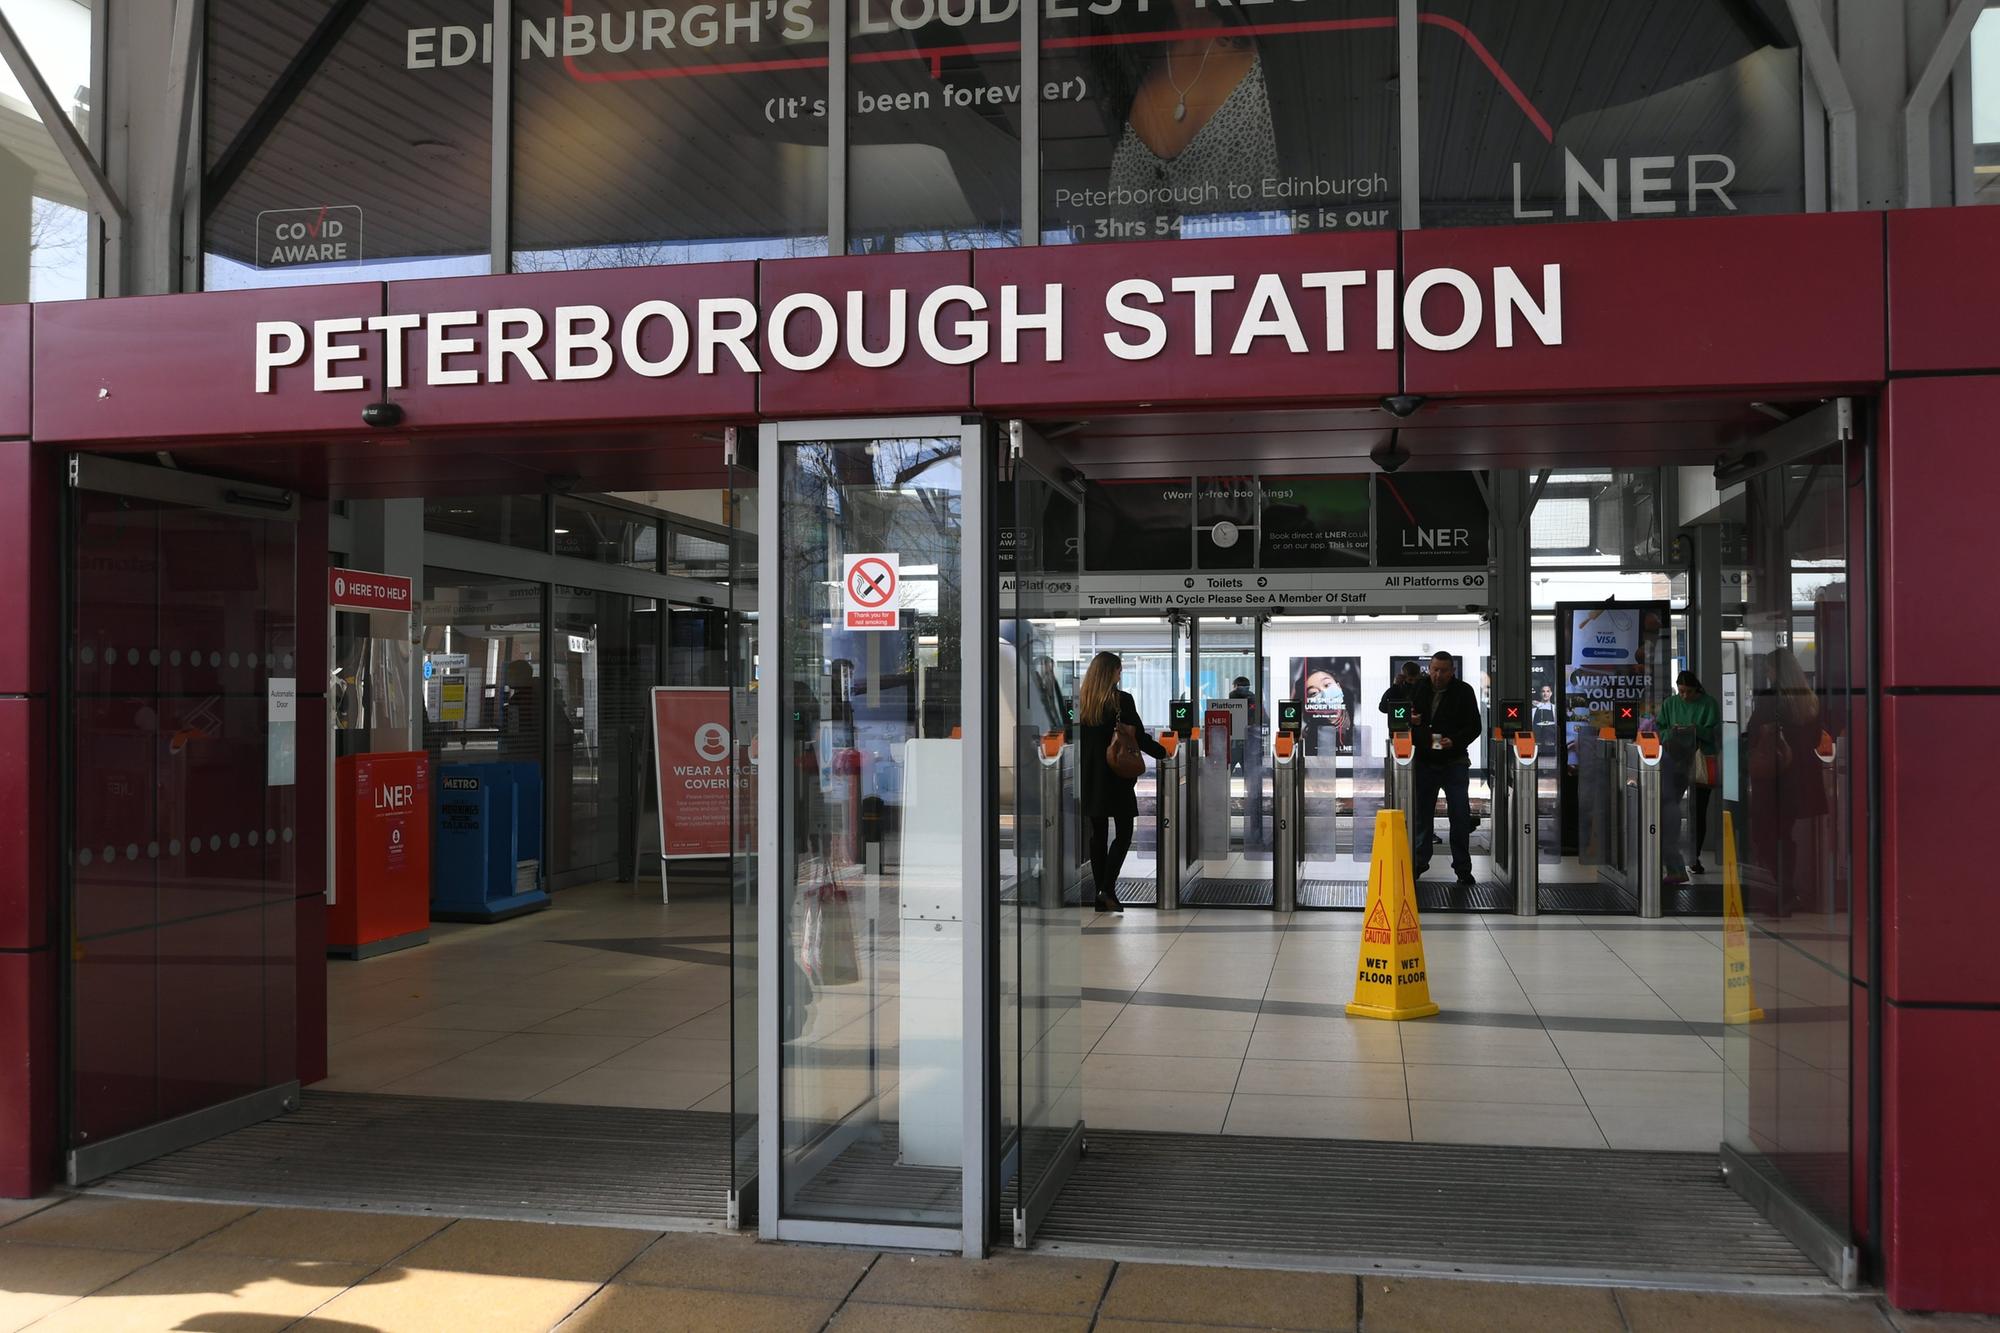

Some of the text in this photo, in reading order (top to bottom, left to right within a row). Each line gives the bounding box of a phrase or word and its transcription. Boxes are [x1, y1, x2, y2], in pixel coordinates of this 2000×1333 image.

[406, 0, 1150, 70] EDINBURGH'S LOUD
[764, 76, 1088, 123] (It's been forever)
[1512, 146, 1738, 222] LNER
[1055, 173, 1388, 208] Peterborough to Edinburgh
[1066, 208, 1390, 240] in 3hrs 54mins. This is our
[270, 243, 347, 263] AWARE
[255, 263, 1564, 394] PETERBOROUGH STATION
[1234, 488, 1295, 500] bookings)
[1270, 531, 1291, 540] Book
[1291, 531, 1314, 540] direct
[1402, 525, 1470, 550] LNER
[1294, 542, 1308, 550] our
[1328, 541, 1345, 549] This
[1346, 541, 1353, 549] is
[1354, 541, 1368, 549] our
[1001, 580, 1016, 591] All
[1207, 577, 1243, 588] Toilets
[1385, 576, 1459, 587] All Platforms
[349, 583, 407, 601] HERE TO HELP
[1088, 592, 1367, 606] Travelling With A Cycle Please See A Member Of Staff
[1595, 635, 1617, 645] VISA
[1576, 675, 1653, 687] WHATEVER
[270, 690, 295, 698] Automatic
[1584, 687, 1645, 699] YOU BUY
[1211, 702, 1243, 710] Platform
[672, 765, 711, 776] WEAR
[714, 765, 724, 776] A
[443, 778, 478, 789] METRO
[684, 779, 750, 790] COVERING
[374, 783, 414, 810] LNER
[1162, 818, 1170, 829] 2
[1279, 819, 1287, 830] 3
[1524, 823, 1531, 834] 5
[1649, 823, 1656, 835] 6
[1364, 929, 1391, 945] CAUTION
[1366, 957, 1388, 969] WET
[1401, 957, 1420, 970] WET
[1359, 971, 1393, 985] FLOOR
[1397, 971, 1425, 986] FLOOR
